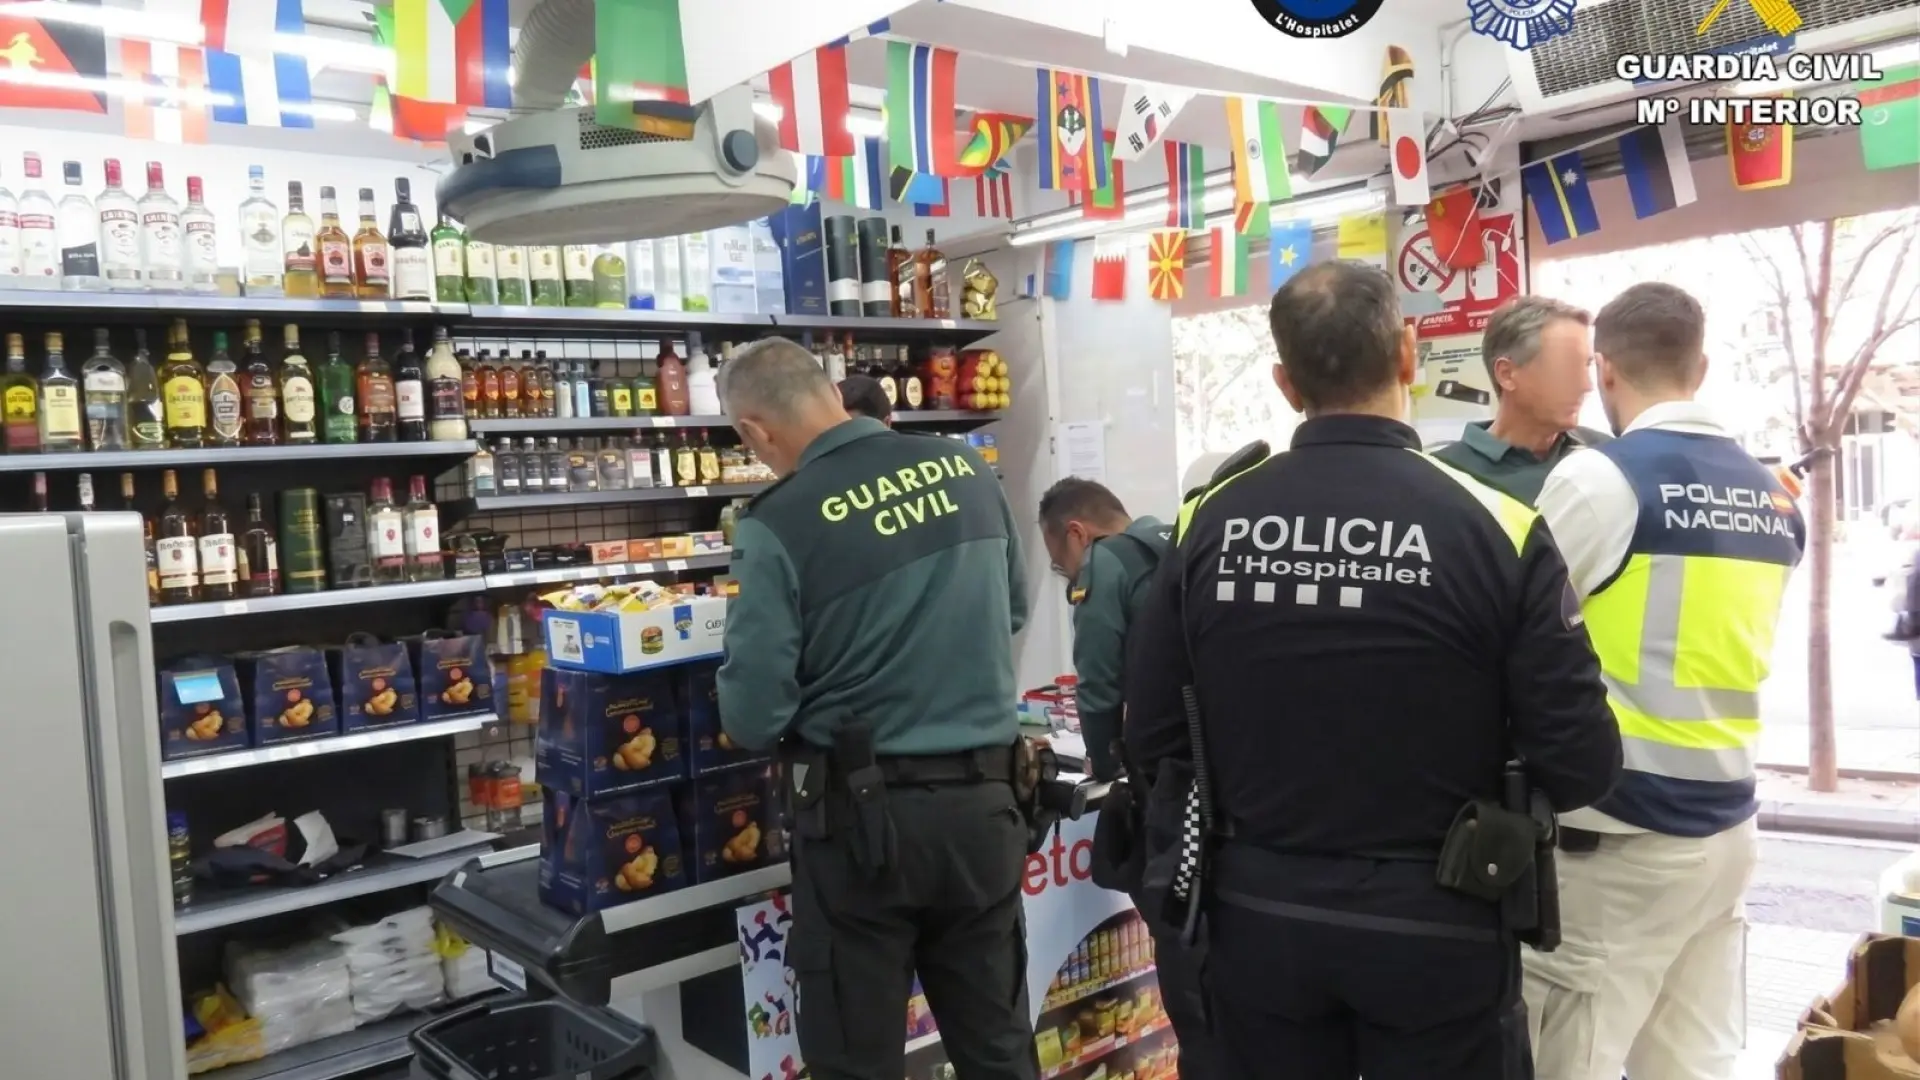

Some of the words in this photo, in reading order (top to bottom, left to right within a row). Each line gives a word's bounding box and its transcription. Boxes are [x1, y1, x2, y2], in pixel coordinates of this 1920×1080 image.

[821, 455, 975, 522] GUARDIA
[1659, 483, 1775, 510] POLICIA
[874, 489, 959, 536] CIVIL
[1665, 509, 1795, 539] NACIONAL
[1221, 515, 1432, 562] POLICIA
[1218, 555, 1432, 587] L'Hospitalet
